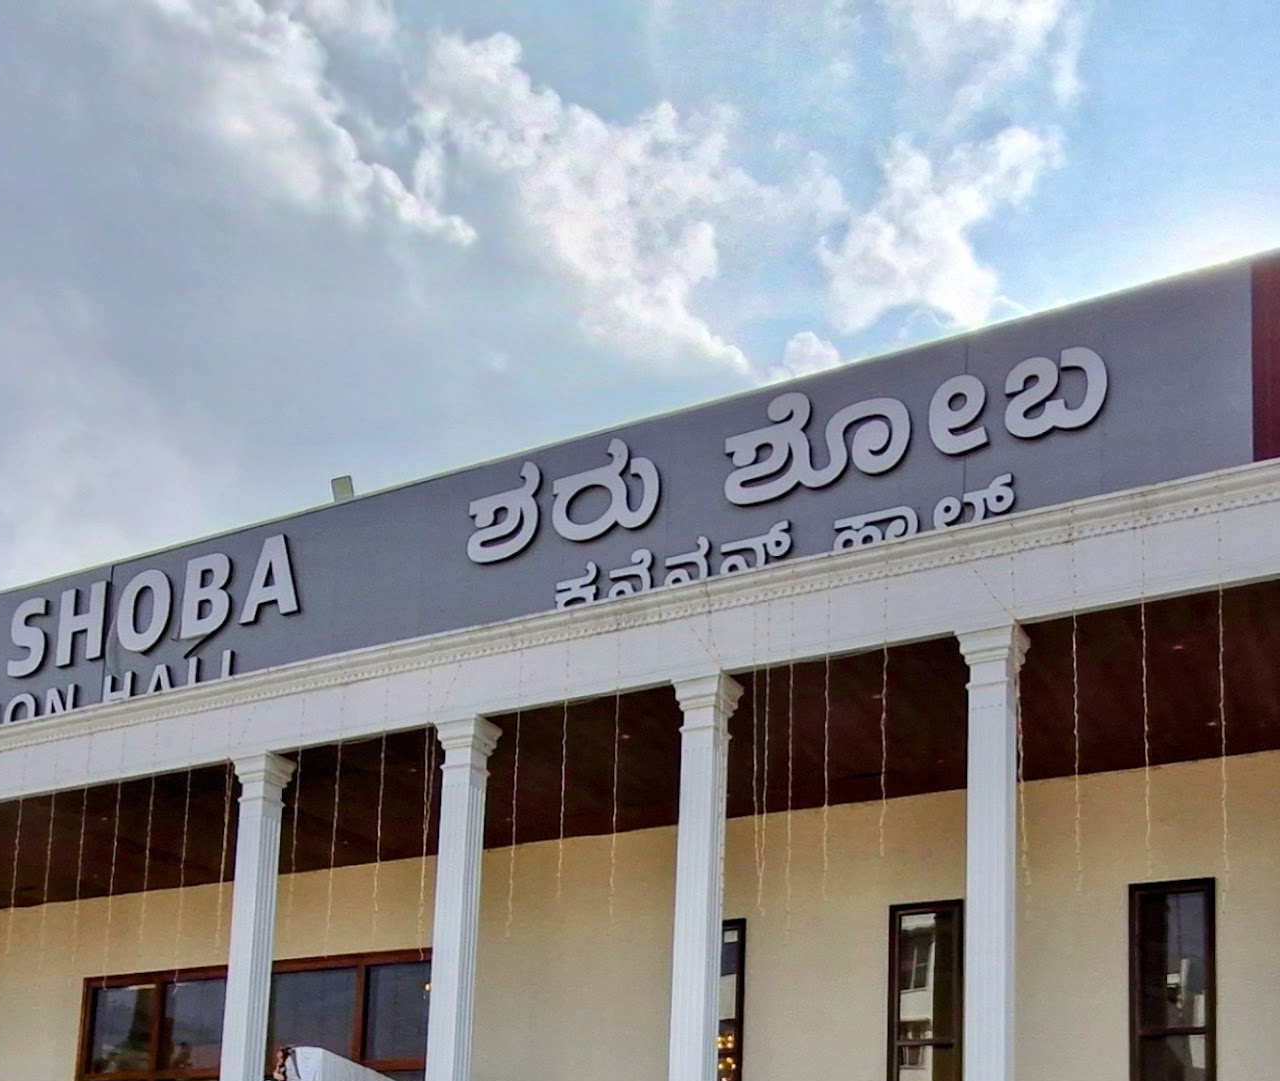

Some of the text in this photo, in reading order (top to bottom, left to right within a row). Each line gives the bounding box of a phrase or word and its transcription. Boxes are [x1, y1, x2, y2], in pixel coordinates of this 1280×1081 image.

[465, 346, 1109, 564] ಶರು ಶೋಬ
[6, 533, 299, 679] SHOBA
